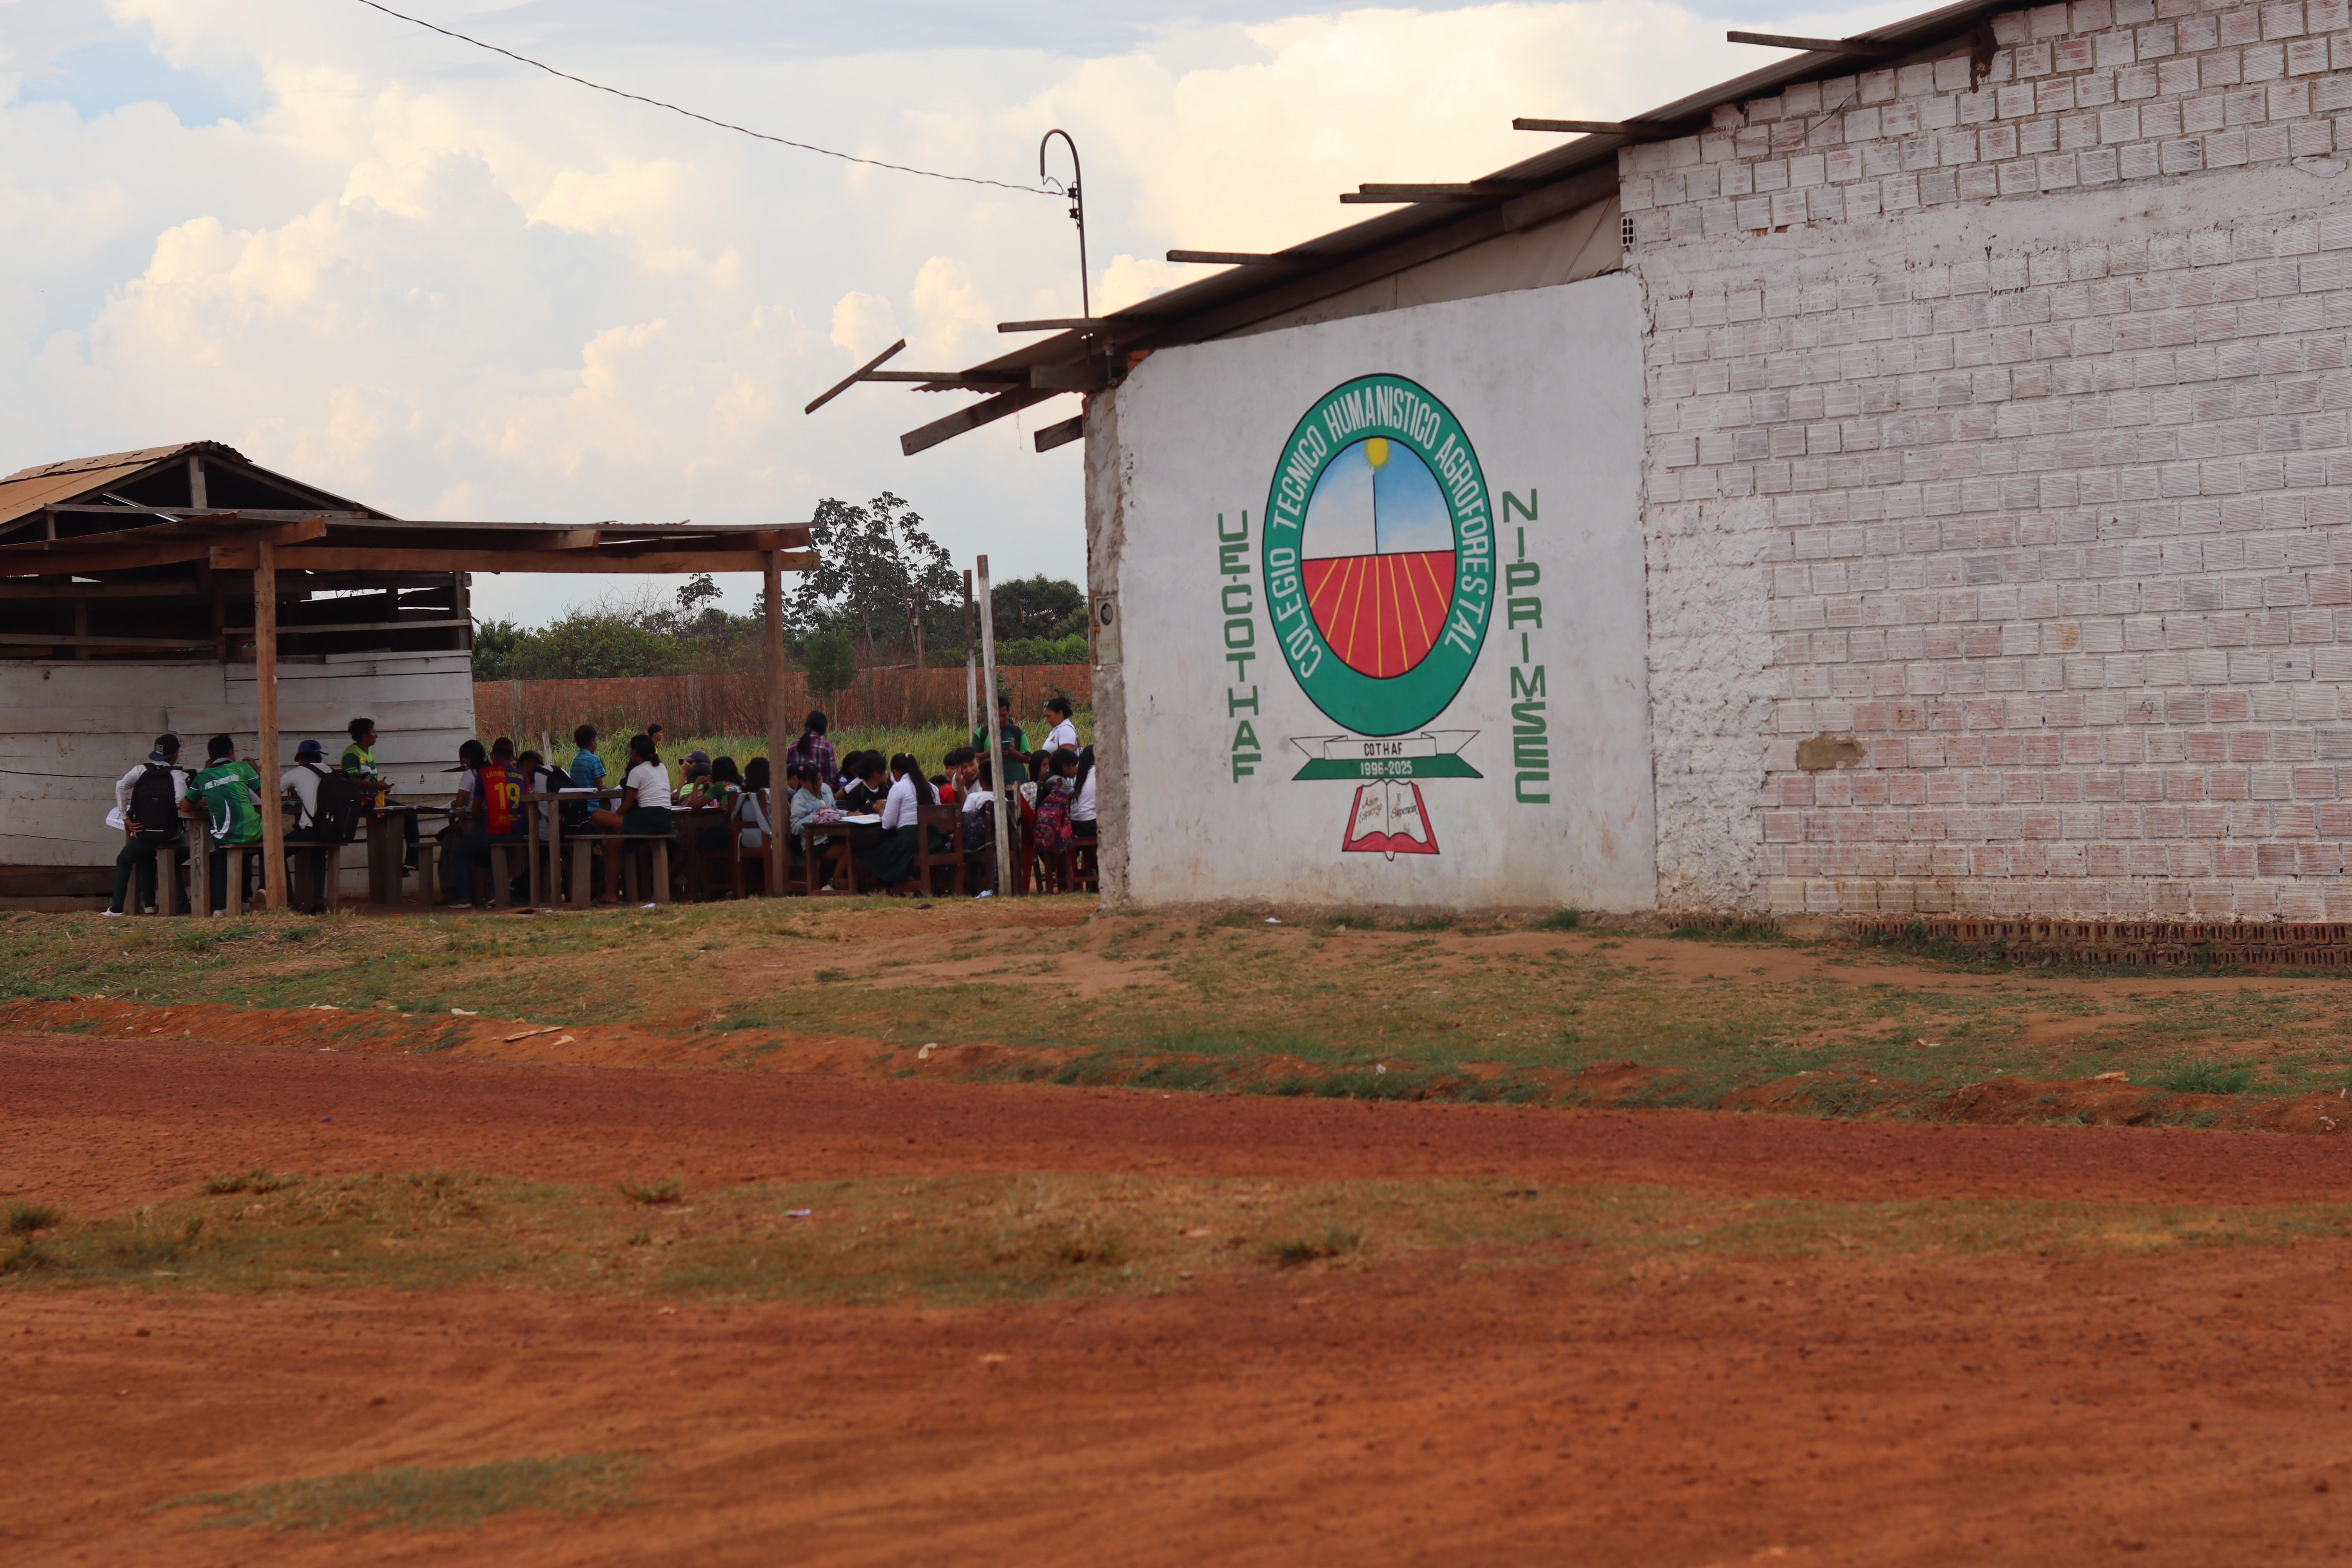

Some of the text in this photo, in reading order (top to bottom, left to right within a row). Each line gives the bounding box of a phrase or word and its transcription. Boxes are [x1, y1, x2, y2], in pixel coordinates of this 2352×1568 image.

[1269, 385, 1489, 678] COLEGIO TECNICO HUMANISTICO AGROFORESTAL
[1364, 742, 1403, 757] COTHAF
[1360, 760, 1413, 776] 1996-2025
[494, 782, 521, 809] 19
